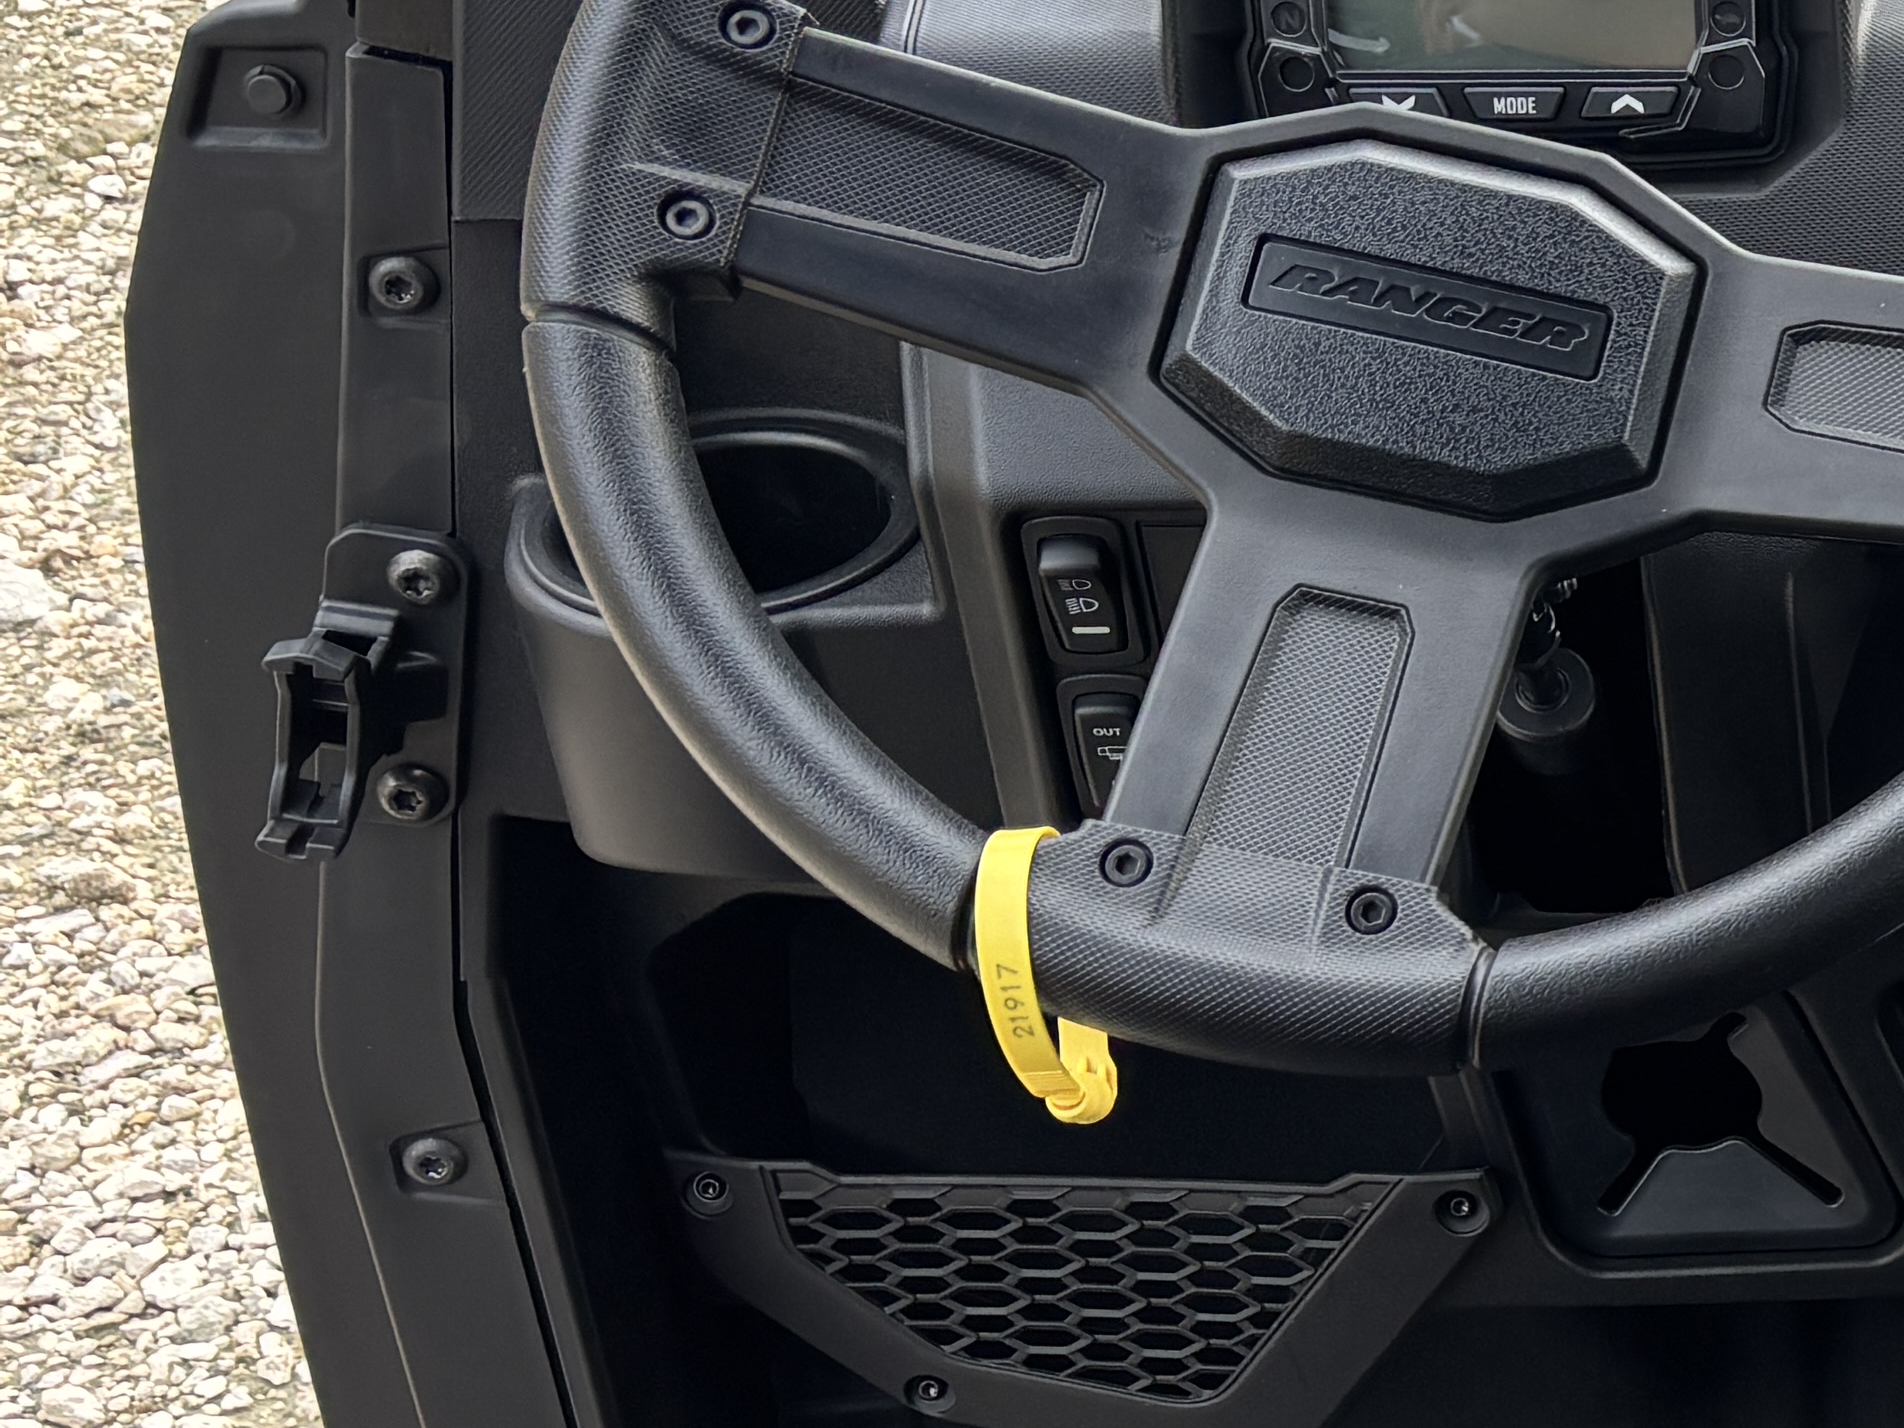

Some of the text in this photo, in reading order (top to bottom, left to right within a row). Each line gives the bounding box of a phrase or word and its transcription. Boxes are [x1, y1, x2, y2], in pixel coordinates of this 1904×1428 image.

[1493, 96, 1537, 115] MODE
[1269, 263, 1590, 352] RANGER
[1093, 727, 1121, 737] OUT
[996, 963, 1034, 1038] 21917
